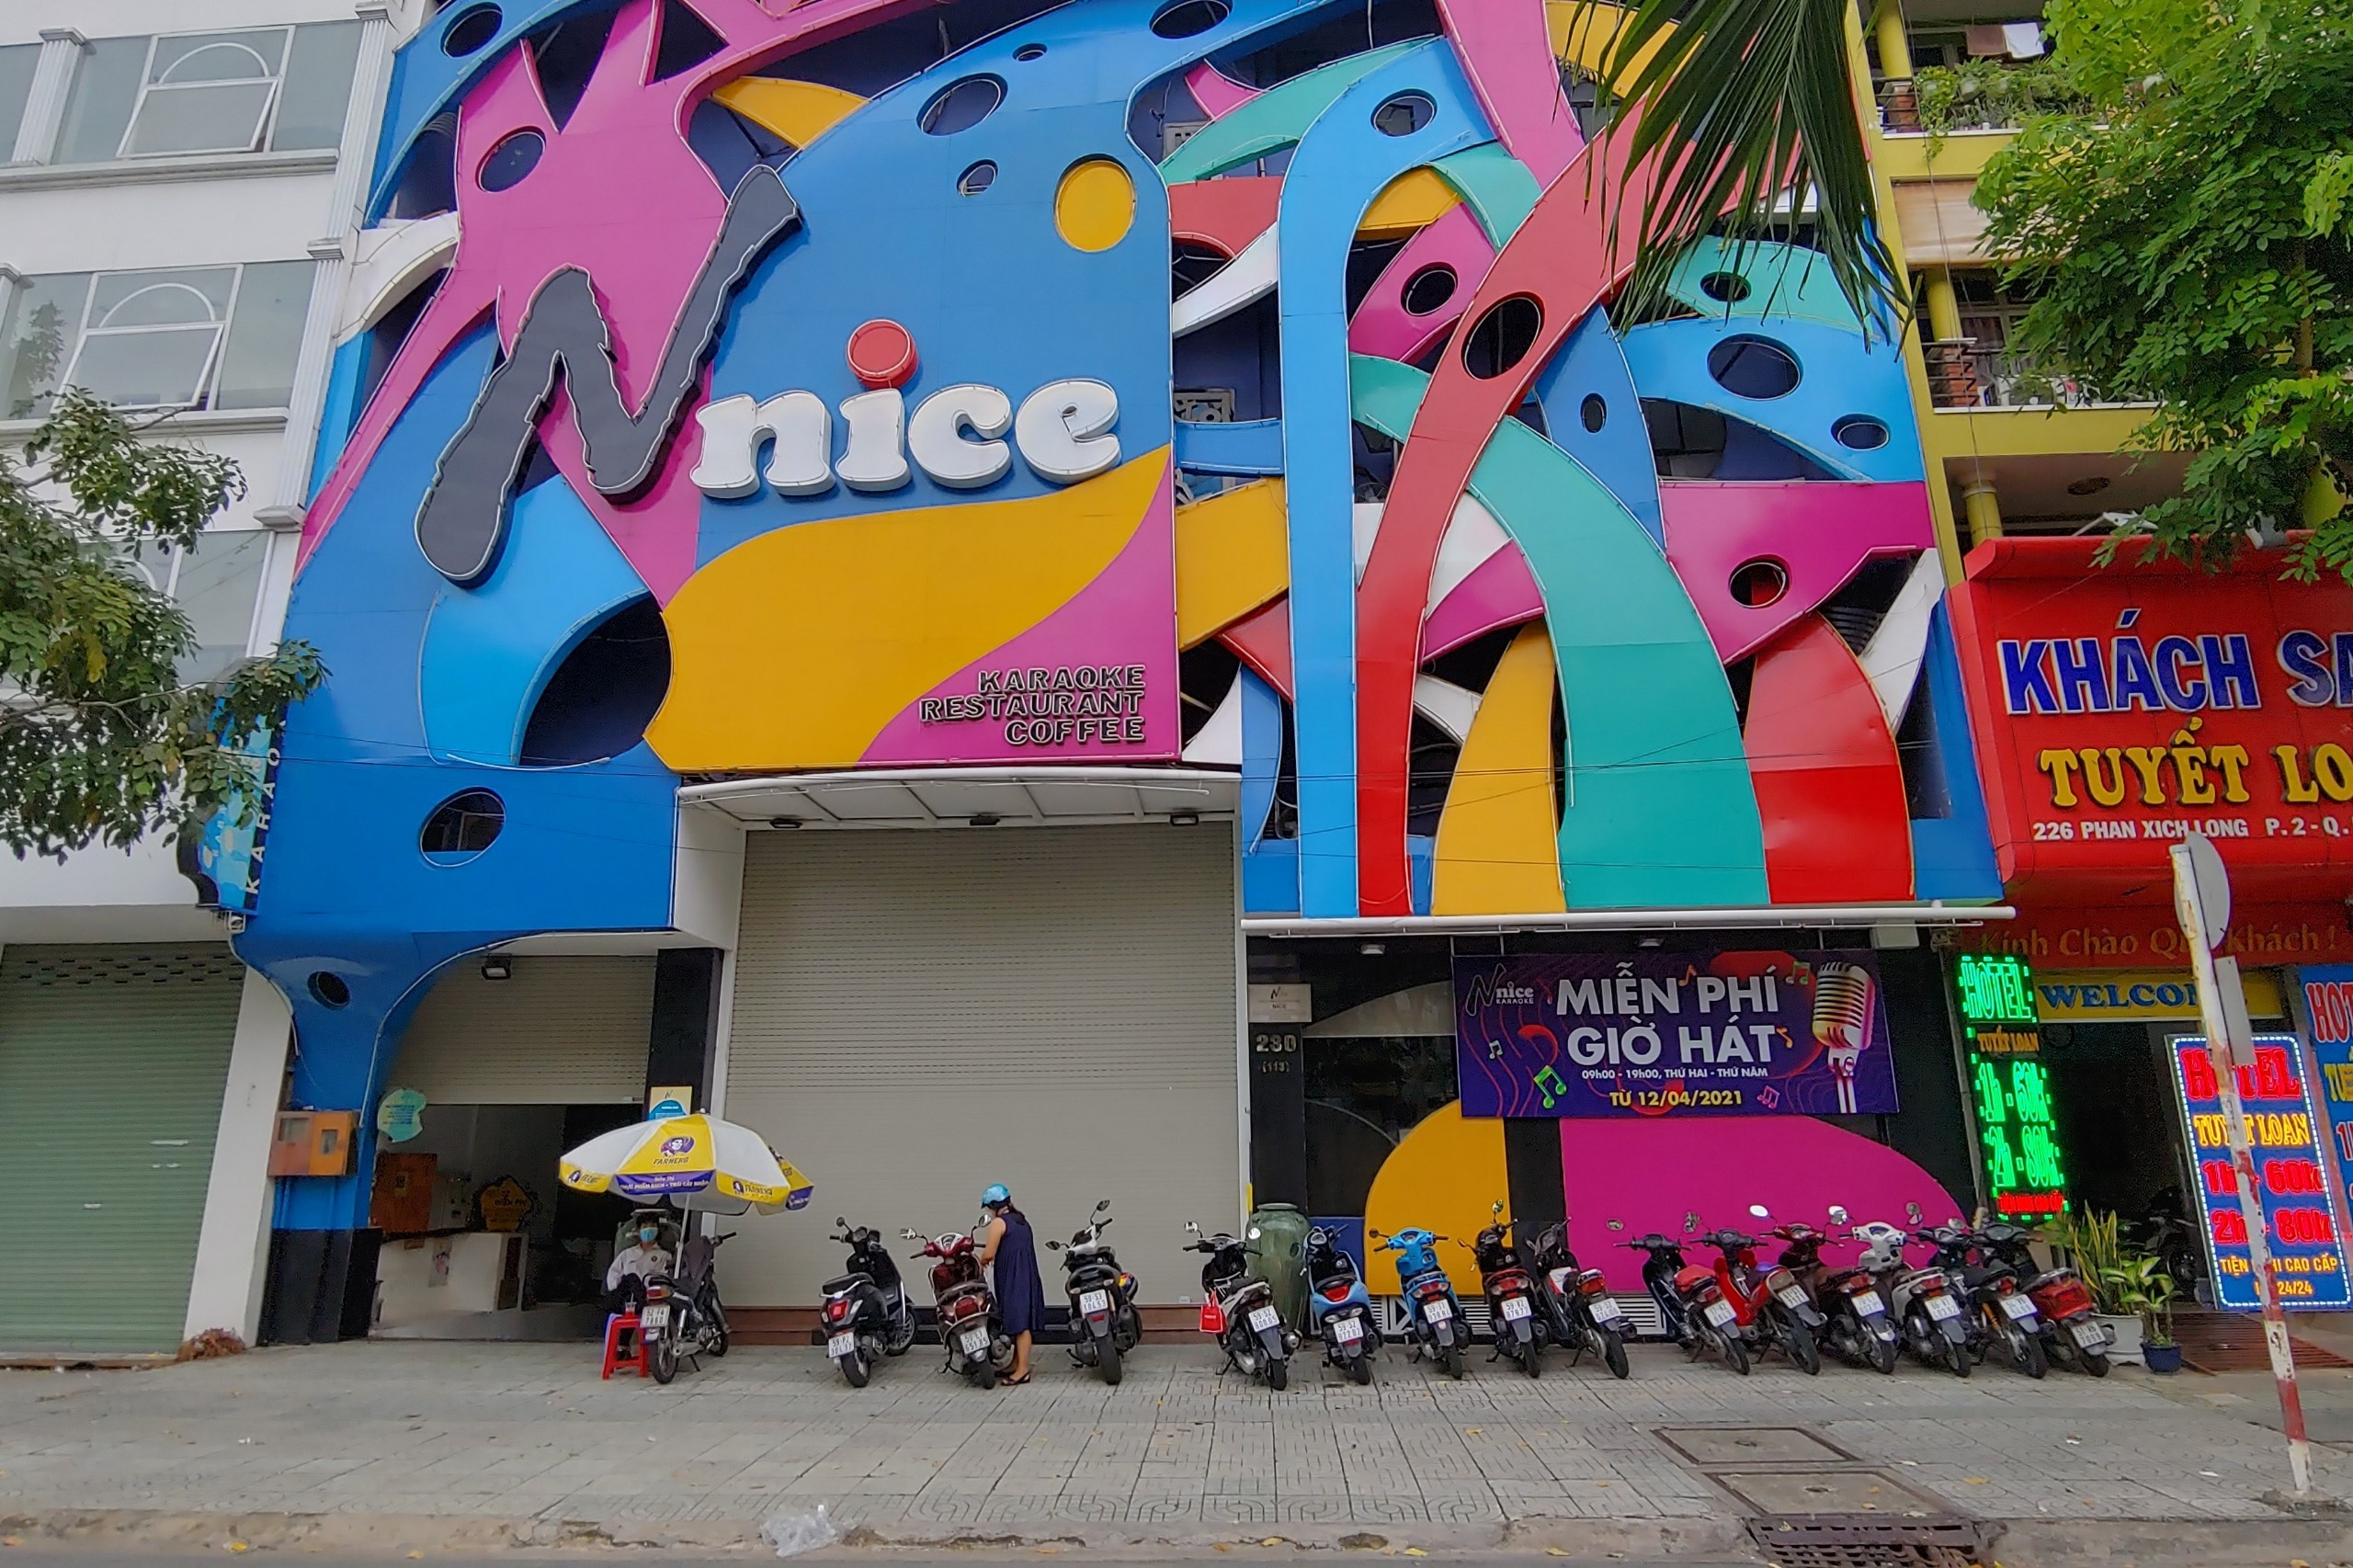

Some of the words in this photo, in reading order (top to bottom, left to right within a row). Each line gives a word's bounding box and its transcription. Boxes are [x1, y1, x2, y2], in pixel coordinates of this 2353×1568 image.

[689, 318, 1122, 499] nice
[1997, 608, 2261, 715] KHÁCH
[978, 665, 1145, 694] KARAOKE
[919, 691, 1144, 722] RESTAURANT
[1005, 717, 1144, 745] COFFEE
[2039, 717, 2250, 806] TUYẾT
[2272, 743, 2353, 805] LO
[2033, 822, 2074, 840] 226
[2080, 820, 2136, 839] PHAN
[2142, 819, 2189, 838] XICH
[2194, 818, 2249, 837] LONG
[1980, 929, 2049, 955] Kính
[2059, 927, 2139, 955] Chào
[2226, 924, 2320, 953] Khách
[1495, 982, 1534, 998] nice
[1557, 962, 1679, 1016] MIỄN
[1697, 965, 1779, 1013] PHÍ
[1961, 962, 2031, 1018] HOTEL
[2038, 983, 2199, 1011] WELCO
[1256, 1034, 1297, 1052] 230
[1567, 1016, 1662, 1066] GIỜ
[1678, 1015, 1776, 1063] HÁT
[1582, 1069, 1616, 1079] 09h00
[1626, 1069, 1662, 1080] 19h00,
[1665, 1067, 1687, 1078] THỨ
[1688, 1068, 1708, 1077] HAI
[1717, 1067, 1739, 1077] THỨ
[1609, 1089, 1631, 1106] TỪ
[1638, 1090, 1742, 1107] 12/04/2021
[2256, 1113, 2311, 1146] LOAN
[2265, 1160, 2325, 1194] 60k
[2275, 1209, 2335, 1244] 80k
[2219, 1255, 2249, 1276] TIỆN
[2285, 1257, 2310, 1273] CAO
[2313, 1252, 2338, 1272] CẤP
[2277, 1281, 2313, 1295] 24/24
